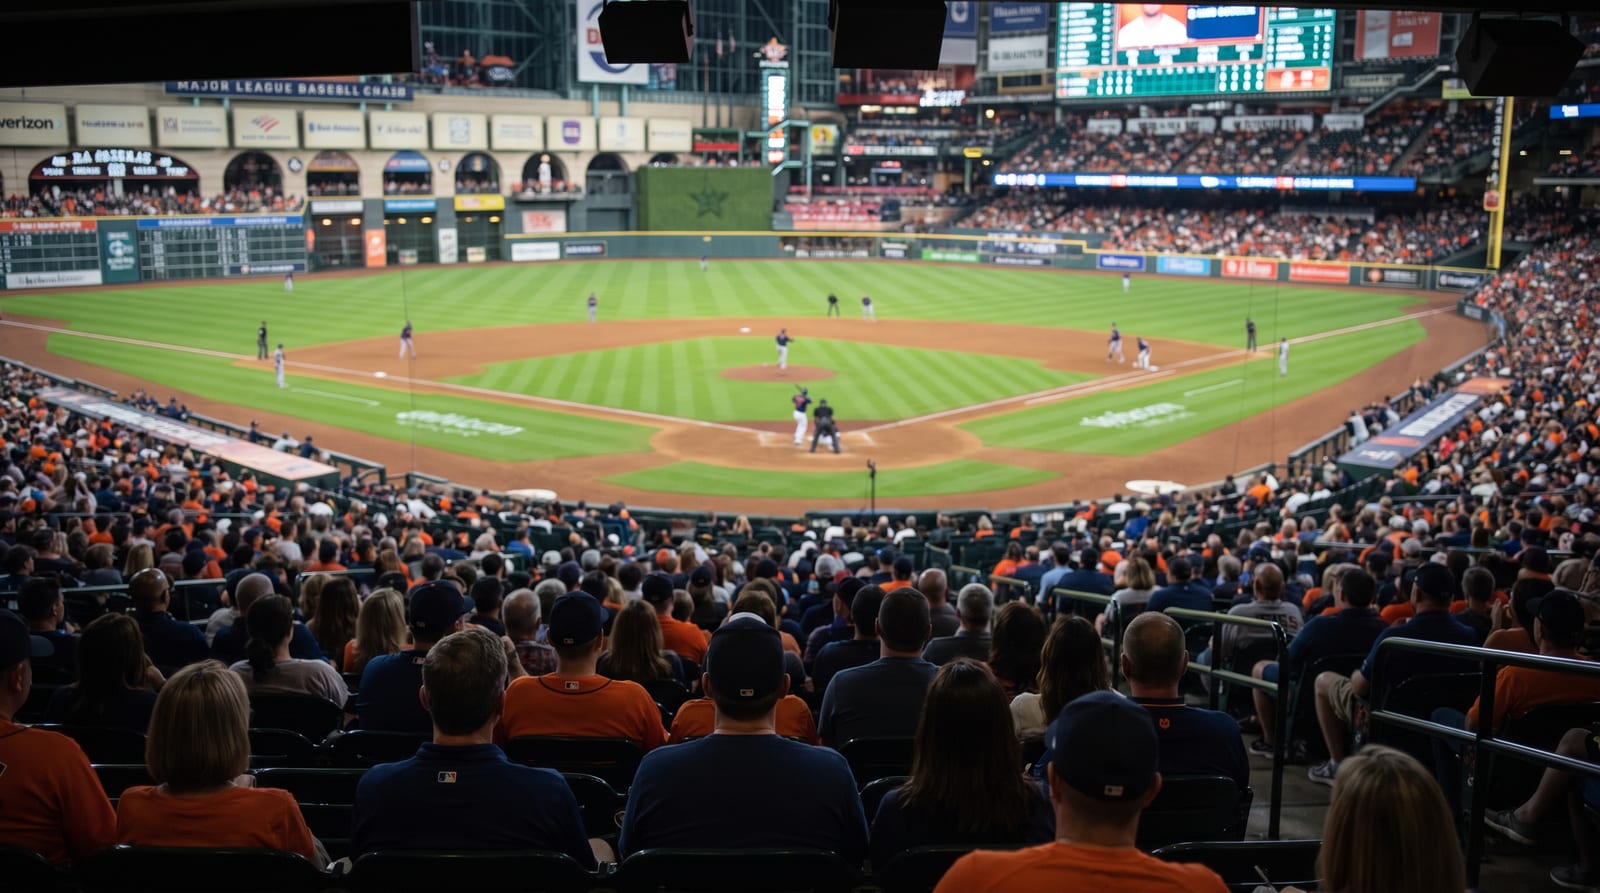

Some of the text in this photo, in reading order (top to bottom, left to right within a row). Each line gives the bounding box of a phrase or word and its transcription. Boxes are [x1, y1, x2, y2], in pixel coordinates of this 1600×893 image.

[177, 80, 230, 92] MAJOR
[235, 81, 293, 94] LEAGUE
[0, 115, 54, 129] verizon
